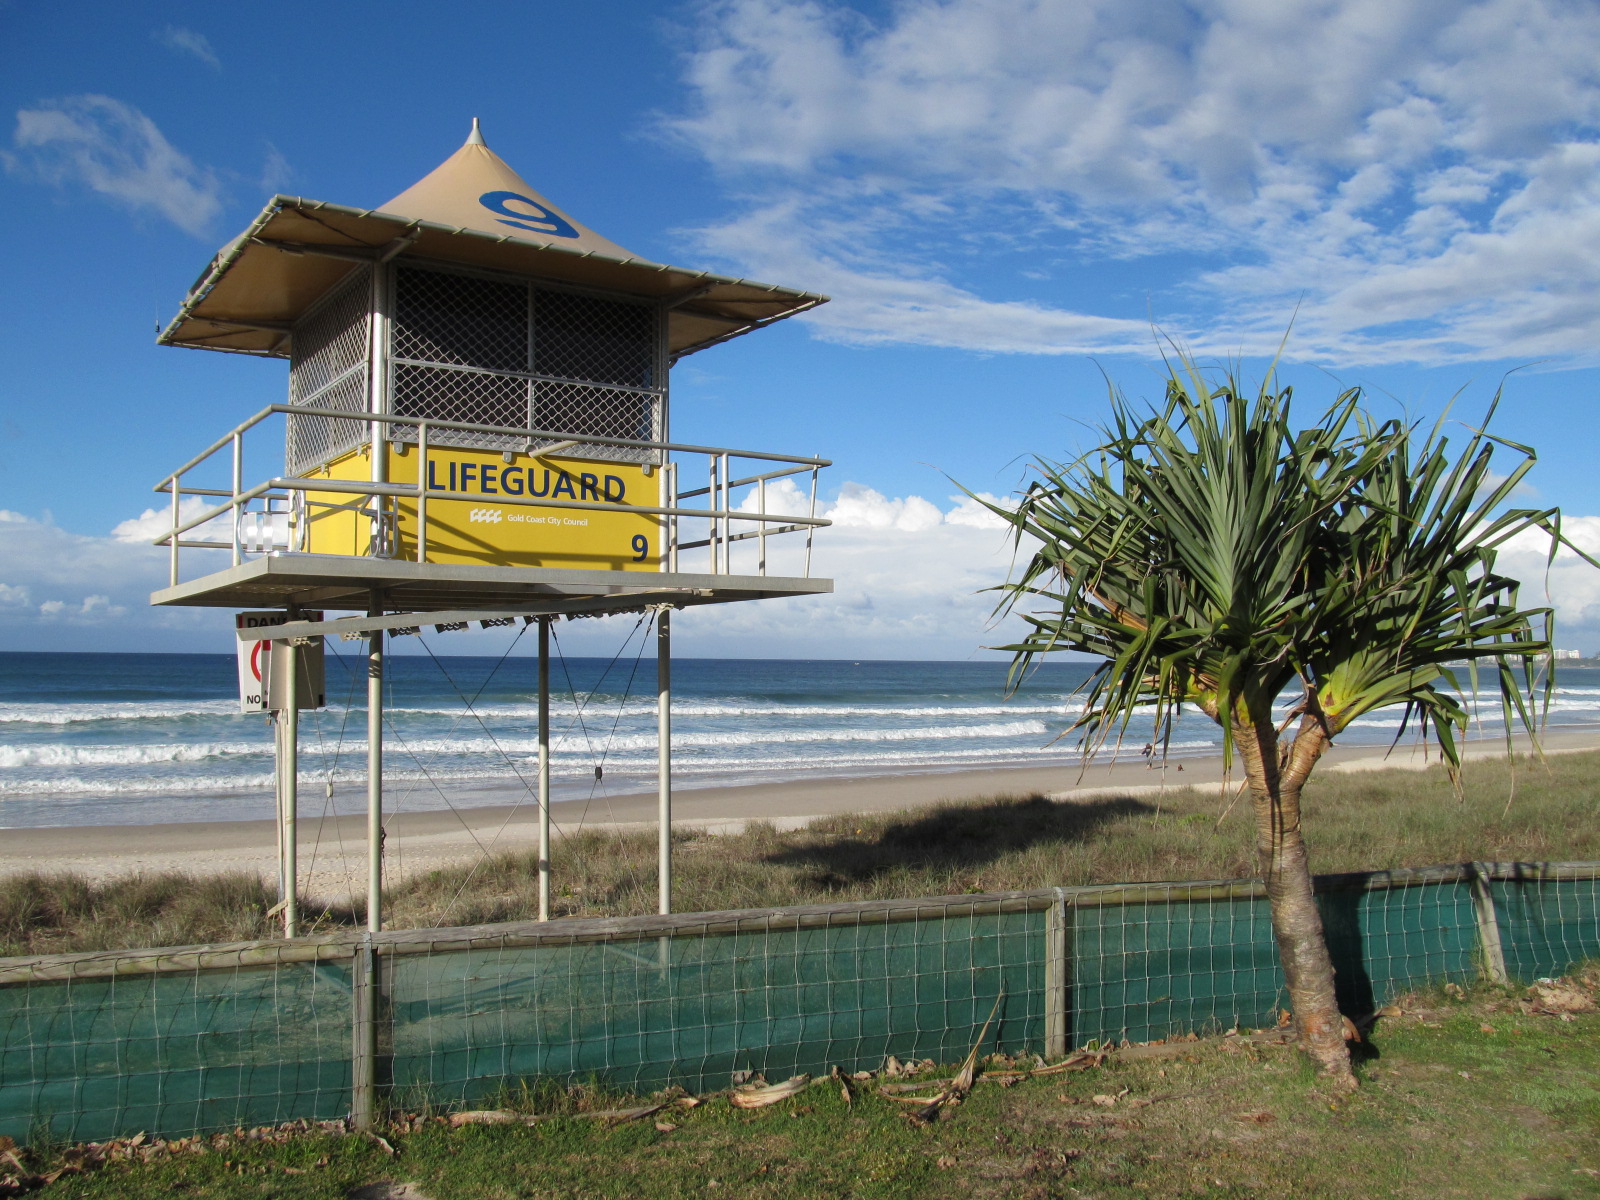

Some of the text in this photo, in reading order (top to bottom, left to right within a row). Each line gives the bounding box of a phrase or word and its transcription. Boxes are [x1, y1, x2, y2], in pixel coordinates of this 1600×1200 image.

[479, 191, 580, 238] 9
[428, 460, 626, 502] LIFEGUARD
[507, 514, 588, 526] Gold Coast City Council
[631, 534, 649, 562] 9
[247, 695, 261, 704] NO
